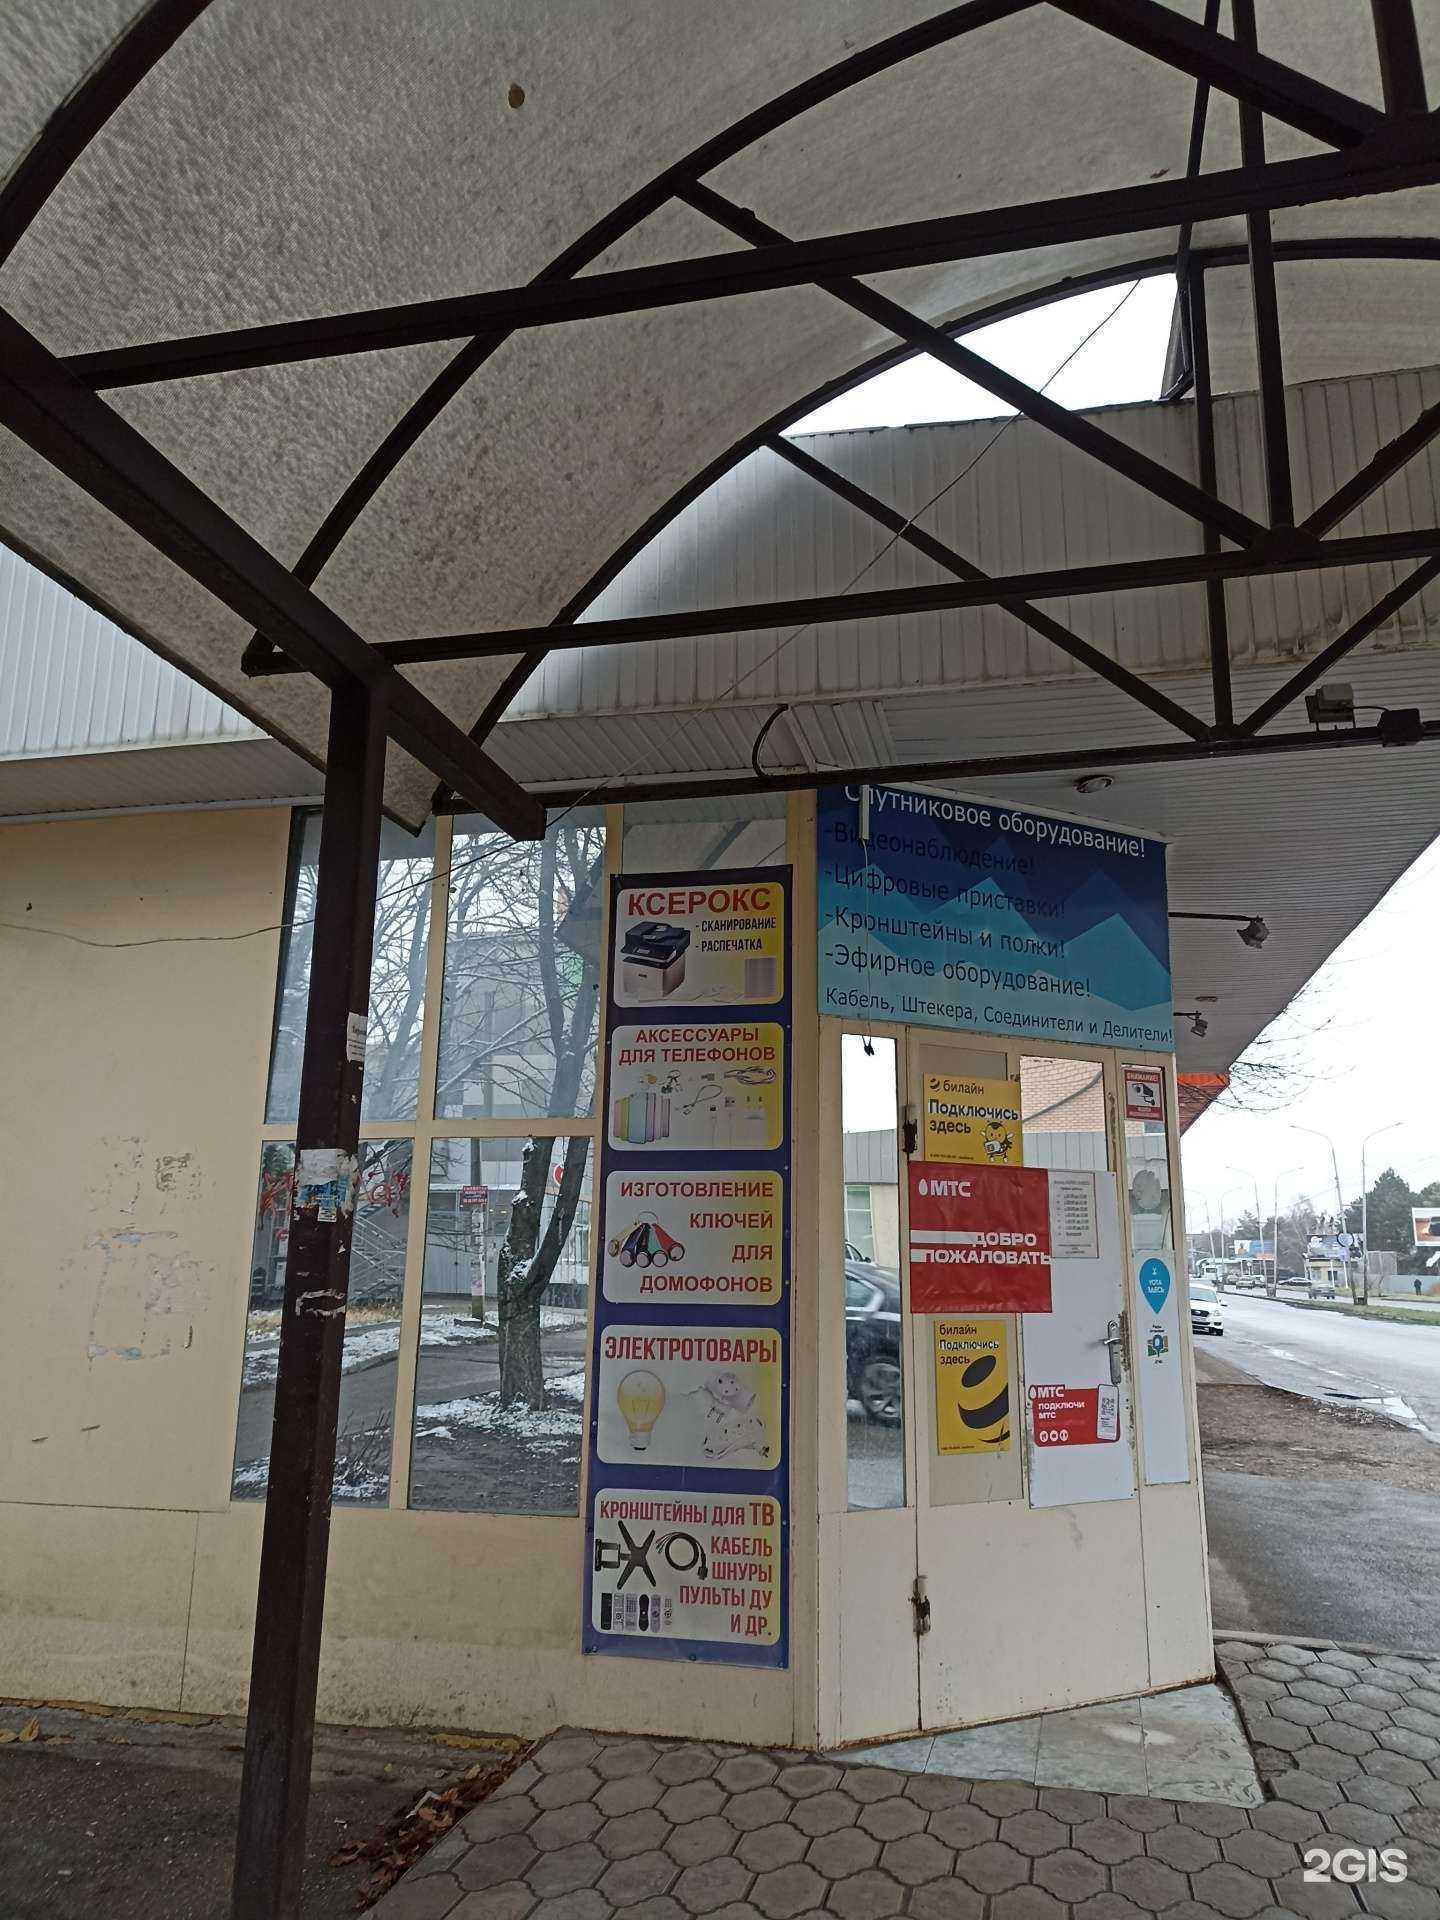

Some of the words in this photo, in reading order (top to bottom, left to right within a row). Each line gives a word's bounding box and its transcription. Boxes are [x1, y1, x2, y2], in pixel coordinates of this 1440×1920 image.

[999, 812, 1146, 858] оборудование!
[628, 887, 771, 916] КСЕРОКС
[957, 888, 1066, 920] приставки!
[701, 917, 777, 932] СКАНИРОВАНИЕ
[701, 938, 762, 952] РАСПЕЧАТКА
[981, 932, 992, 948] и
[1000, 937, 1065, 959] полки!
[942, 959, 1091, 998] оборудование!
[826, 986, 895, 1014] Кабель,
[902, 995, 978, 1024] Штекера,
[983, 1006, 1084, 1033] Соединители
[1088, 1023, 1098, 1035] и
[1102, 1021, 1173, 1043] Делители!
[635, 1027, 759, 1043] АКСЕССУАРЫ
[619, 1048, 655, 1066] ДЛЯ
[661, 1046, 775, 1063] ТЕЛЕФОНОВ
[943, 1080, 984, 1095] билайн
[928, 1099, 1018, 1120] Подключись
[929, 1119, 972, 1134] здесь
[621, 1182, 773, 1198] ИЗГОТОВЛЕНИЕ
[930, 1180, 972, 1197] МТС
[690, 1209, 773, 1229] КЛЮЧЕЙ
[971, 1231, 1037, 1248] ДОБРО
[732, 1245, 773, 1264] ДЛЯ
[922, 1248, 1051, 1265] ПОЖАЛОВАТЬ
[640, 1275, 773, 1293] ДОМОФОНОВ
[939, 1323, 977, 1335] билайн
[605, 1336, 777, 1363] ЭЛЕКТРОТОВАРЫ
[939, 1339, 999, 1351] Подключись
[940, 1355, 970, 1366] здесь
[1037, 1386, 1065, 1398] МТС
[600, 1500, 707, 1524] КРОНШТЕЙНЫ
[711, 1507, 745, 1527] ДЛЯ
[749, 1502, 775, 1526] ТВ
[711, 1536, 773, 1558] КАБЕЛЬ
[712, 1562, 772, 1583] ШНУРЫ
[679, 1585, 745, 1607] ПУЛЬТЫ
[749, 1589, 773, 1611] ДУ
[730, 1614, 741, 1633] И
[745, 1615, 772, 1636] ДР.
